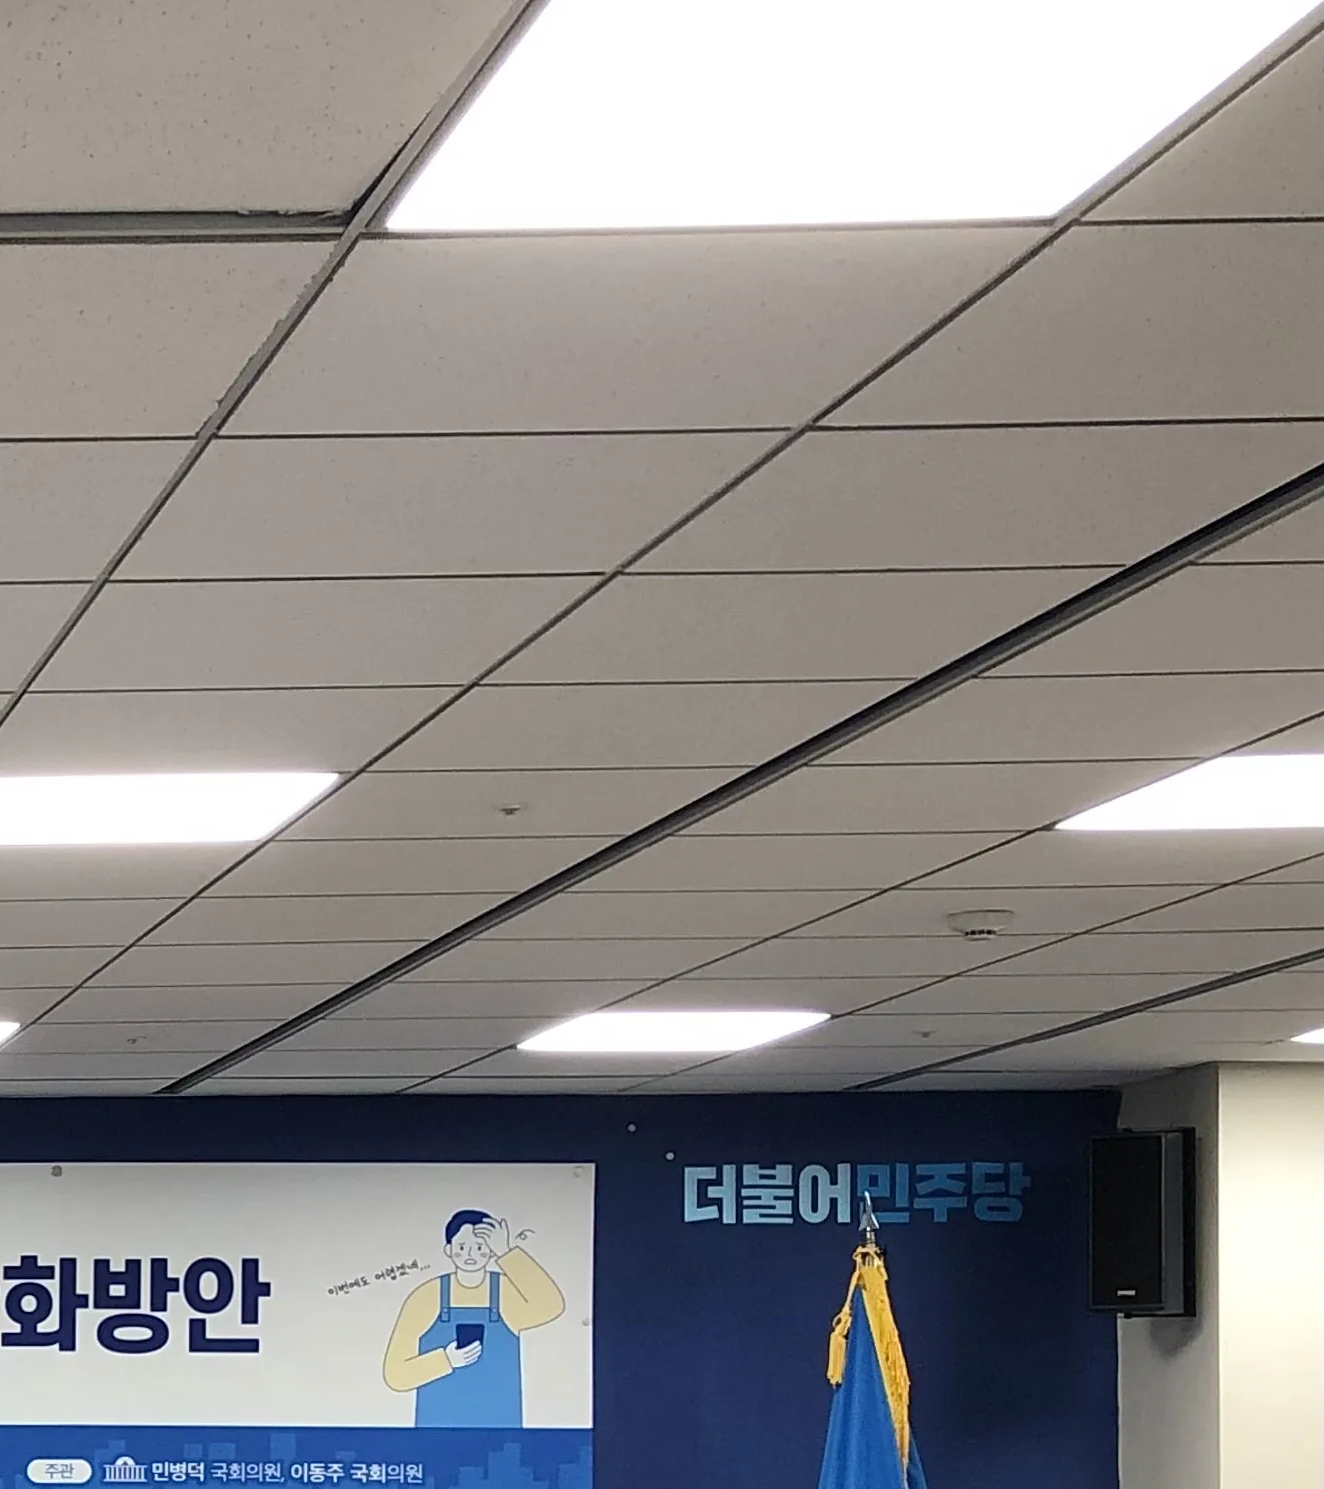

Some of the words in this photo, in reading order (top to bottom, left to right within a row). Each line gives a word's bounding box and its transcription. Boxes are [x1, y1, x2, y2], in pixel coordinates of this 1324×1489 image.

[684, 1162, 1031, 1225] 더불어민주당
[43, 1463, 75, 1480] 주관
[152, 1462, 205, 1482] 민병덕
[210, 1462, 286, 1484] 국회의원,
[290, 1462, 346, 1484] 이동주
[349, 1462, 424, 1484] 국회의원
